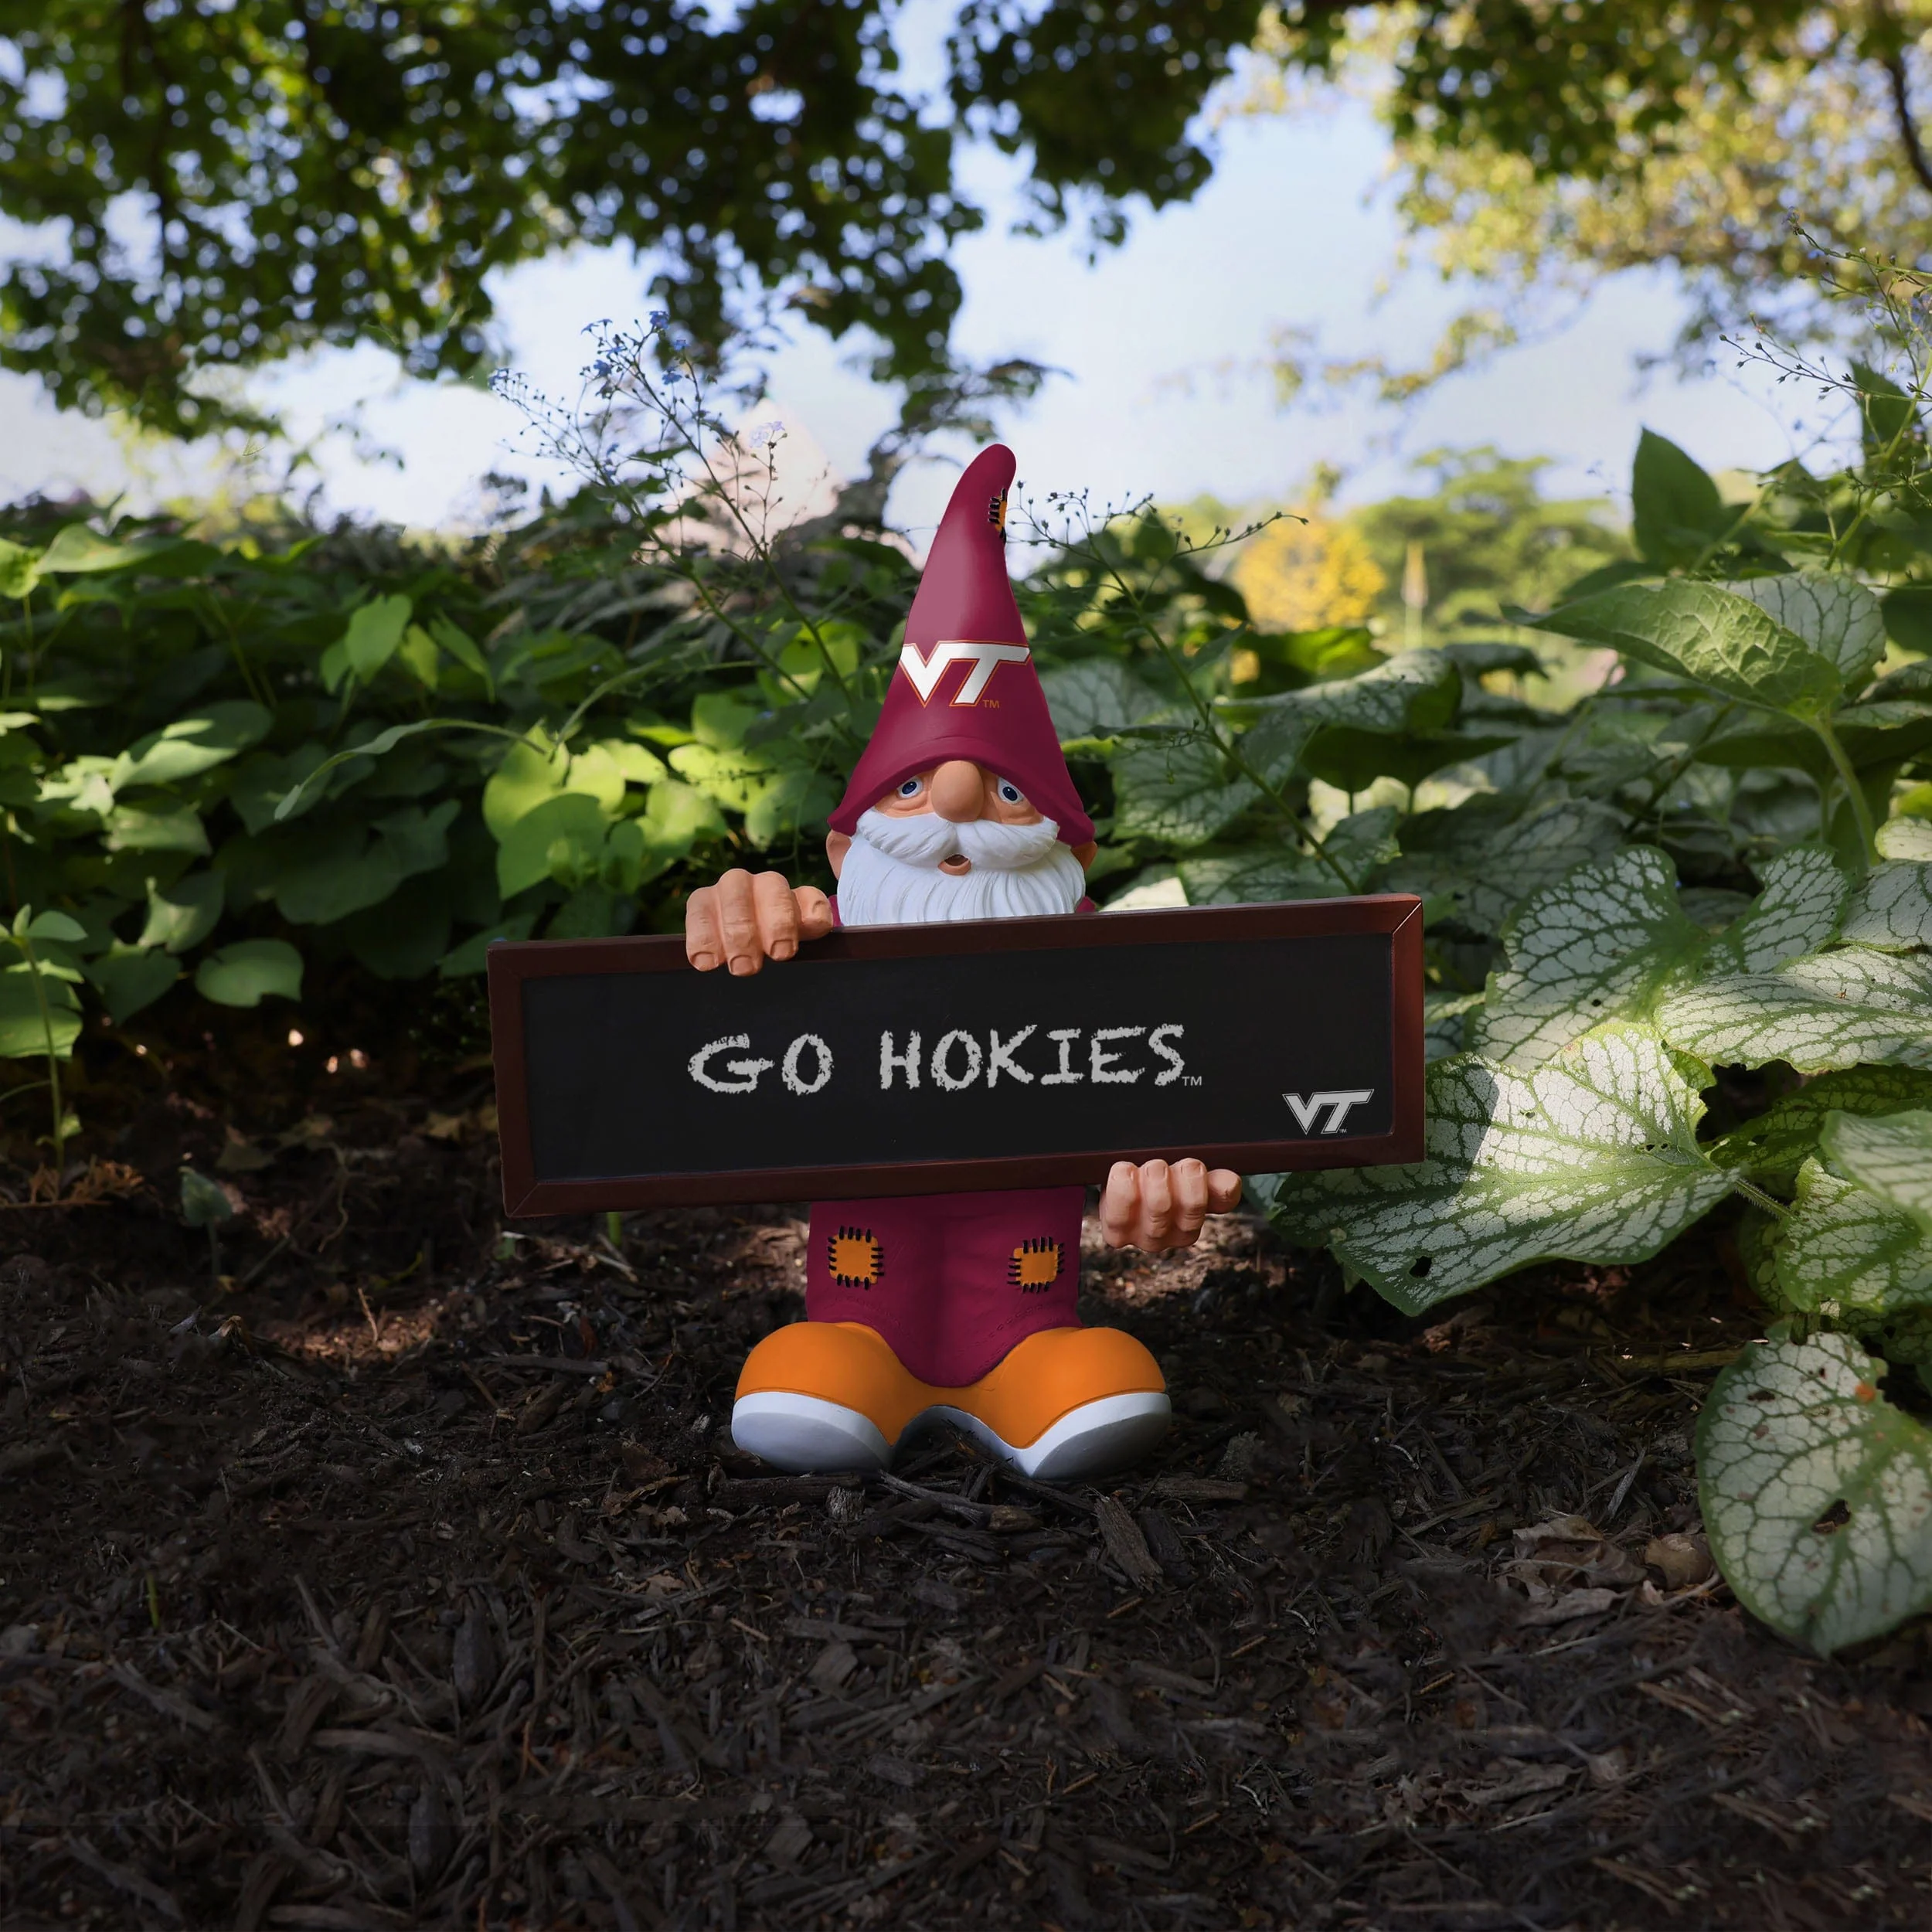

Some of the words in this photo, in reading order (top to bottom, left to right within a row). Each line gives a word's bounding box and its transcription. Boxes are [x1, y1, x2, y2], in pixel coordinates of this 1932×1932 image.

[899, 639, 1031, 708] VT
[982, 699, 1000, 709] TM
[687, 1032, 834, 1096] GO
[879, 1023, 1185, 1091] HOKIES
[1281, 1088, 1375, 1135] VT
